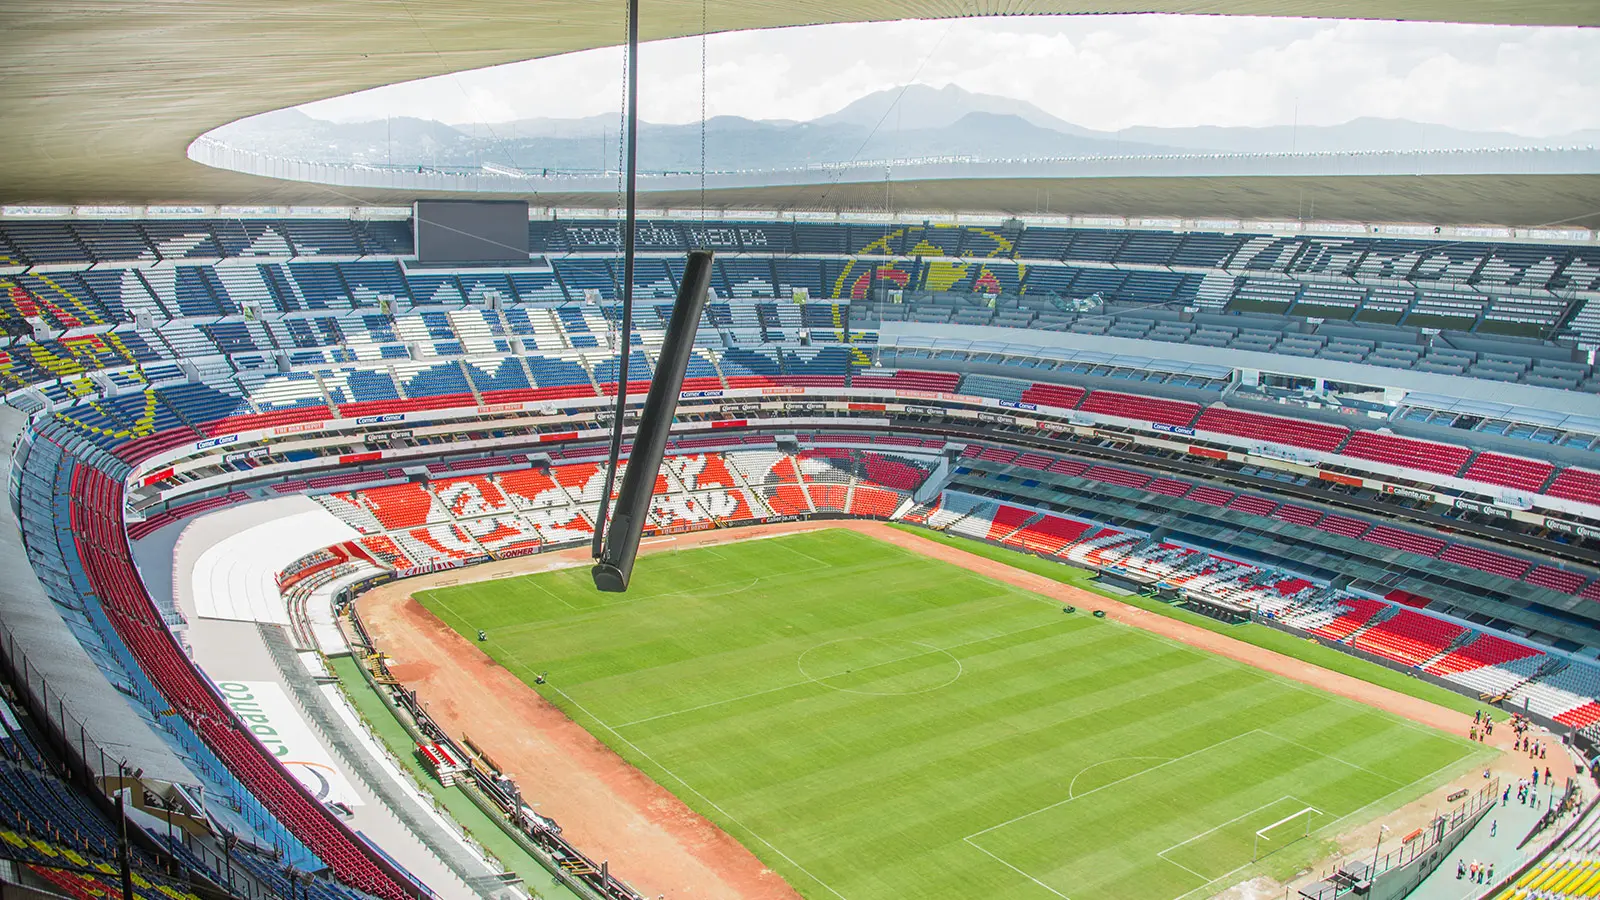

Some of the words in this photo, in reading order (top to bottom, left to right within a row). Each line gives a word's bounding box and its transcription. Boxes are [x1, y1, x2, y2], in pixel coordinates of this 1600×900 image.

[1000, 399, 1015, 407] Comex
[1018, 402, 1036, 410] Comex
[358, 416, 378, 425] Comex
[382, 414, 402, 422] Comex
[1153, 423, 1172, 432] Comex
[1174, 426, 1194, 435] Comex
[197, 438, 216, 450] Comex
[218, 434, 236, 445] Comex
[225, 452, 245, 464] Corona
[248, 447, 268, 459] Corona
[1454, 499, 1480, 512] Corona
[1482, 504, 1508, 517] Corona
[1545, 518, 1572, 532] Corona
[501, 547, 534, 559] GONHER
